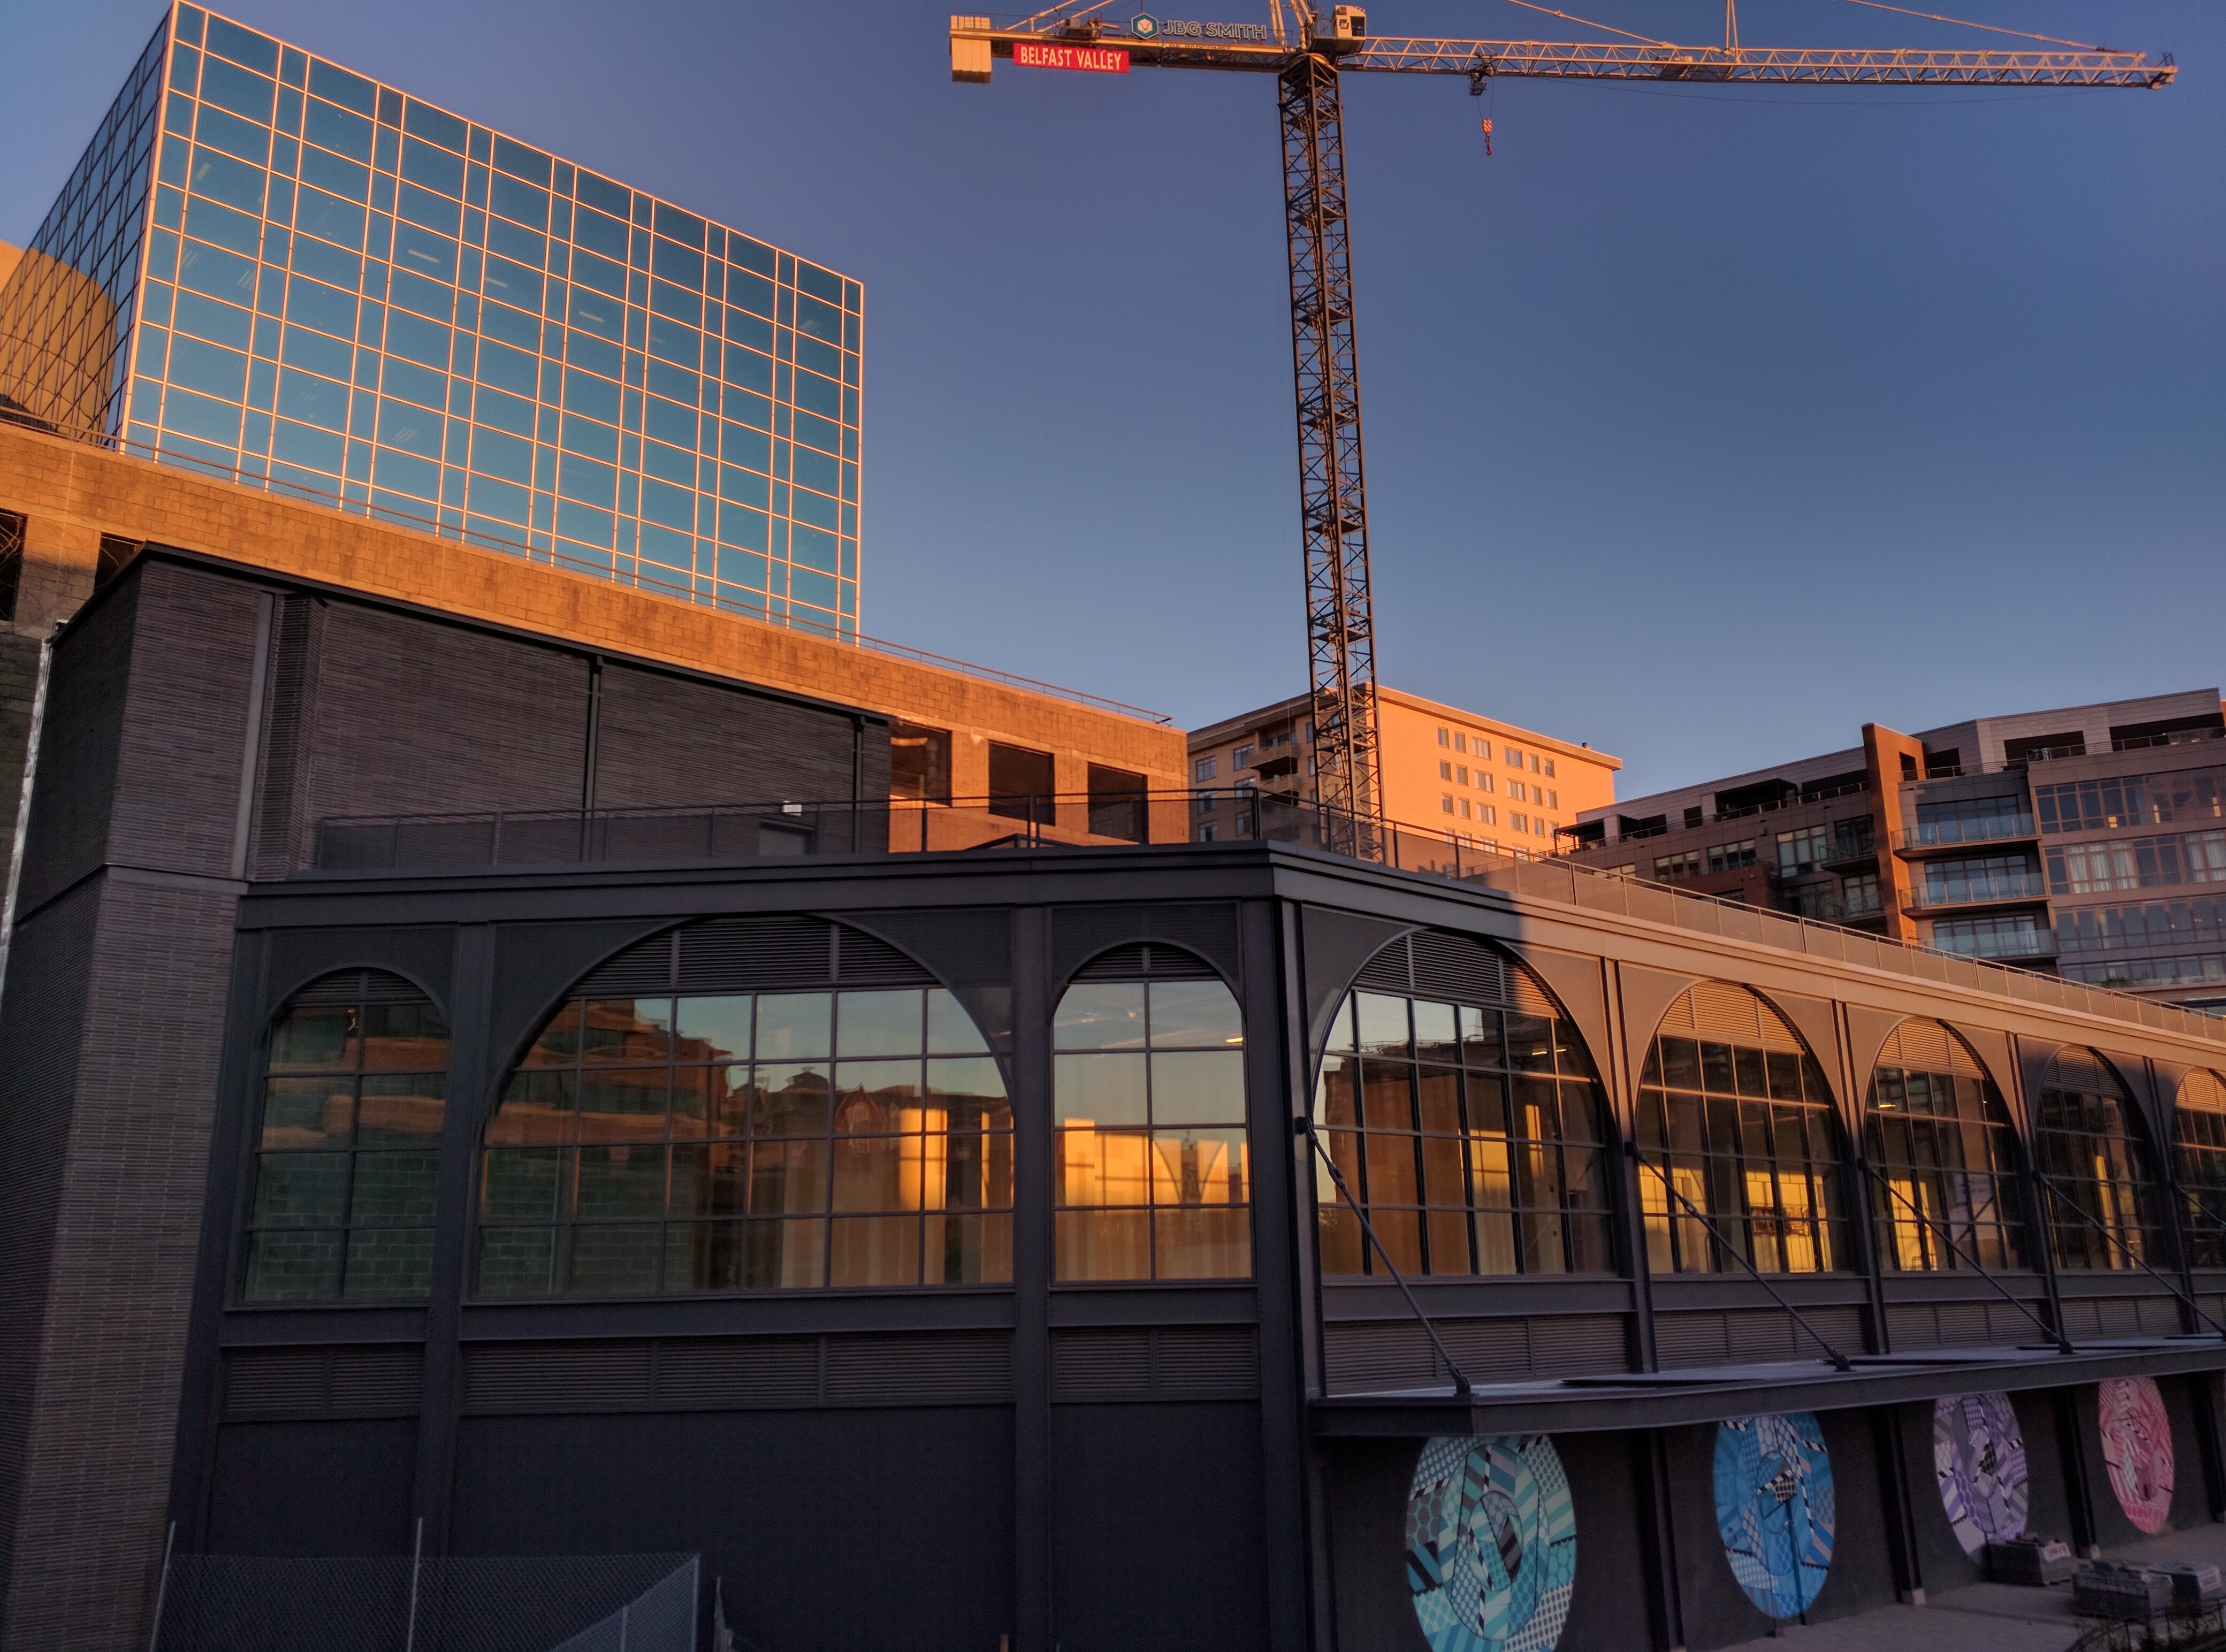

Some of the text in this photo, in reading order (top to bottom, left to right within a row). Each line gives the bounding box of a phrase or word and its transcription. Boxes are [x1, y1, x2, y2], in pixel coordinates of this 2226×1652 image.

[1163, 20, 1267, 40] JBG SMITH
[1020, 46, 1122, 70] BELFAST VALLEY
